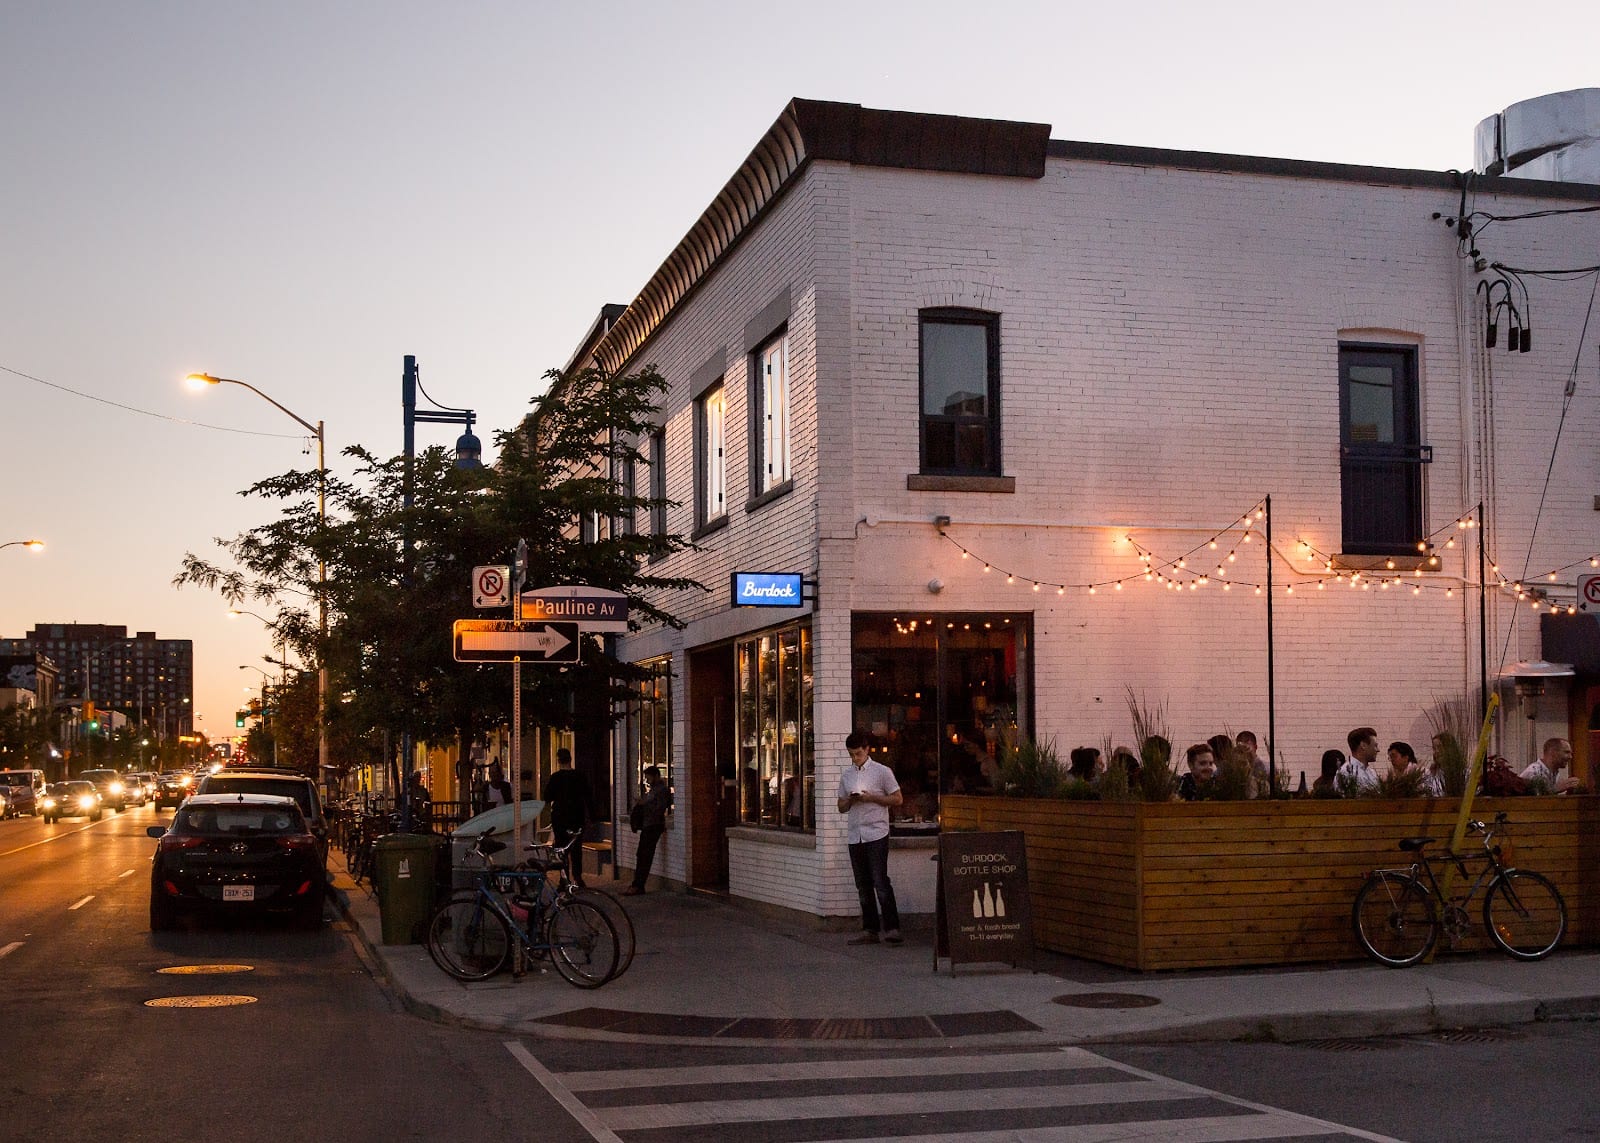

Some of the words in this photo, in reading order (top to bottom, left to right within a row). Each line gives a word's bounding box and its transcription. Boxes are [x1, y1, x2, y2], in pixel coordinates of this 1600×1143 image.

[742, 581, 796, 597] Burdock
[535, 598, 596, 615] Pauline
[600, 603, 615, 615] Av
[961, 853, 1009, 863] BURDOCK
[953, 866, 990, 875] BOTTLE
[991, 864, 1017, 874] SHOP
